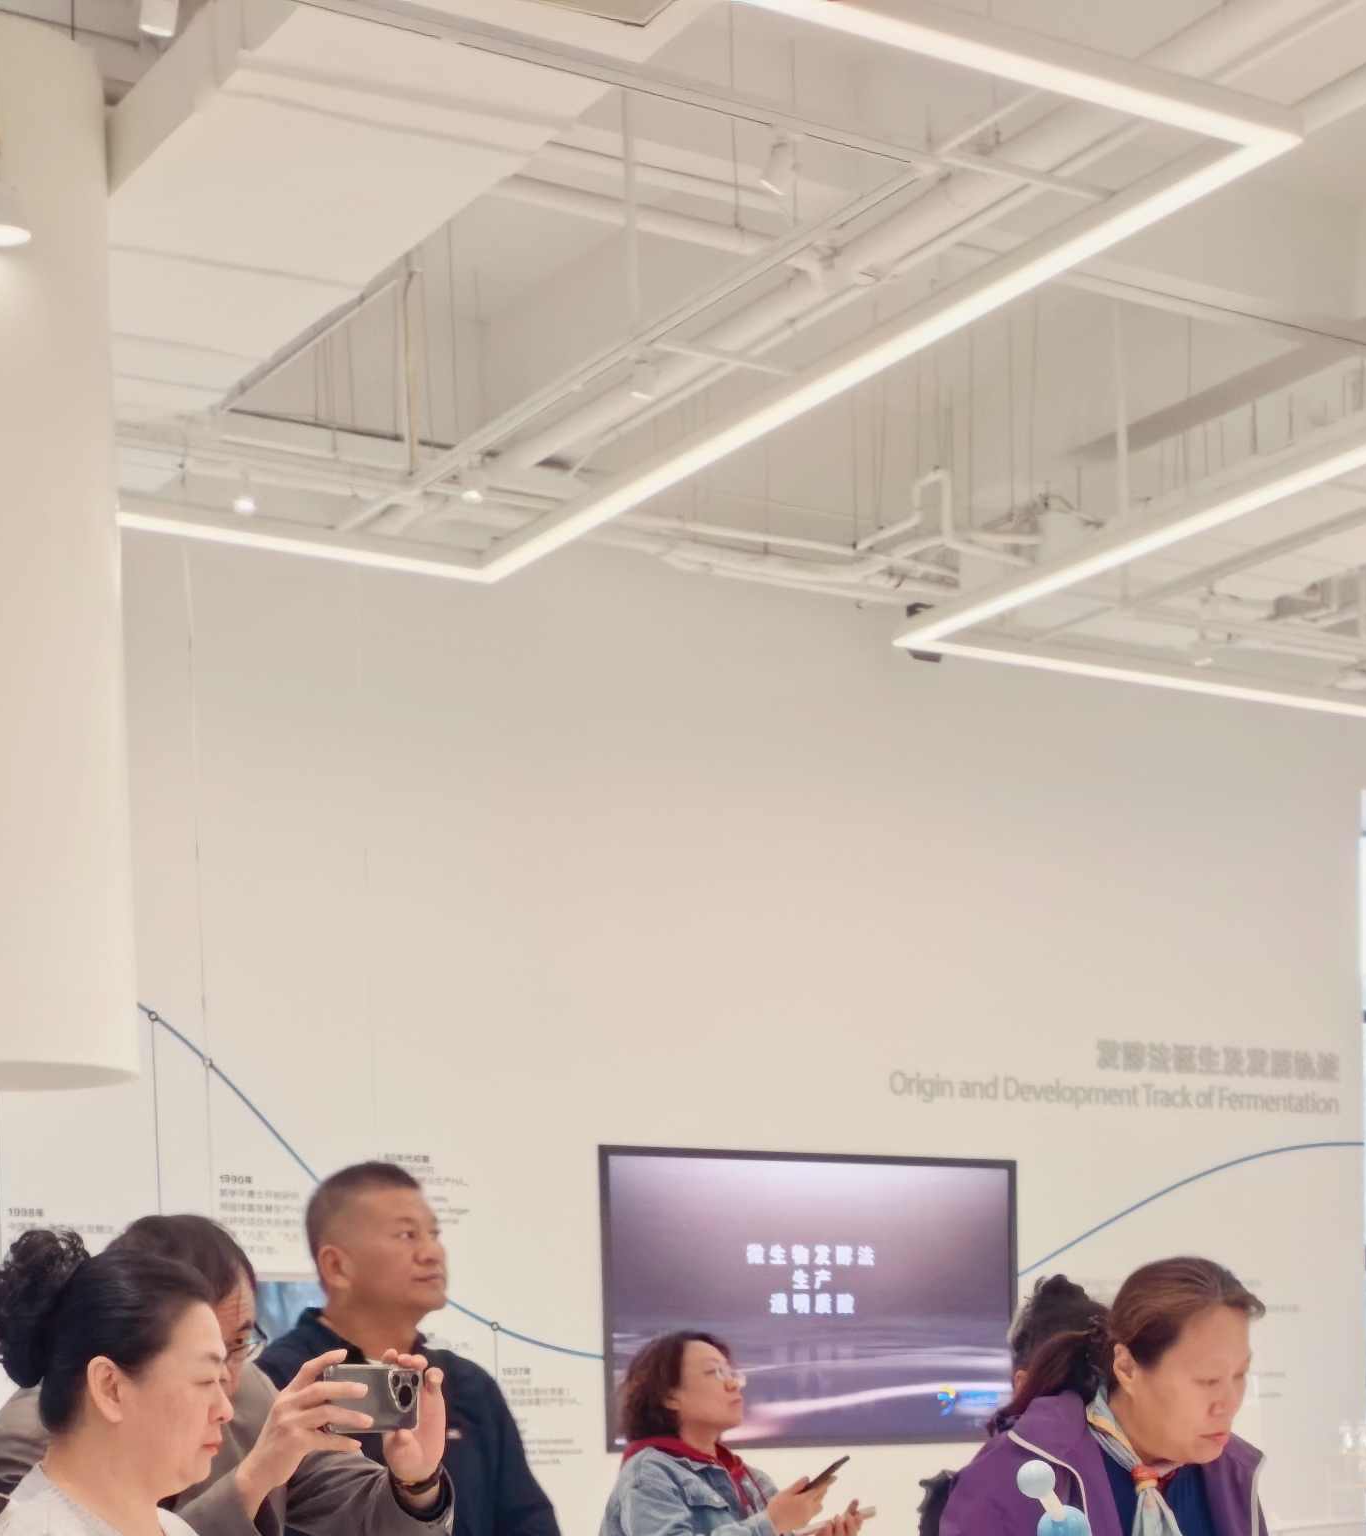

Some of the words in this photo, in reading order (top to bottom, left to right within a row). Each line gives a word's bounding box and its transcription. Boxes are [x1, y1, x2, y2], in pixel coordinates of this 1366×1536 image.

[889, 1069, 954, 1103] Origin
[958, 1074, 999, 1100] and
[1003, 1076, 1140, 1110] Development
[1142, 1082, 1193, 1109] Track
[1195, 1084, 1218, 1109] of
[1219, 1086, 1341, 1115] Fermentation
[746, 1243, 875, 1266] 微生物发酵法
[792, 1268, 833, 1290] 生产
[769, 1292, 855, 1315] 透明质酸
